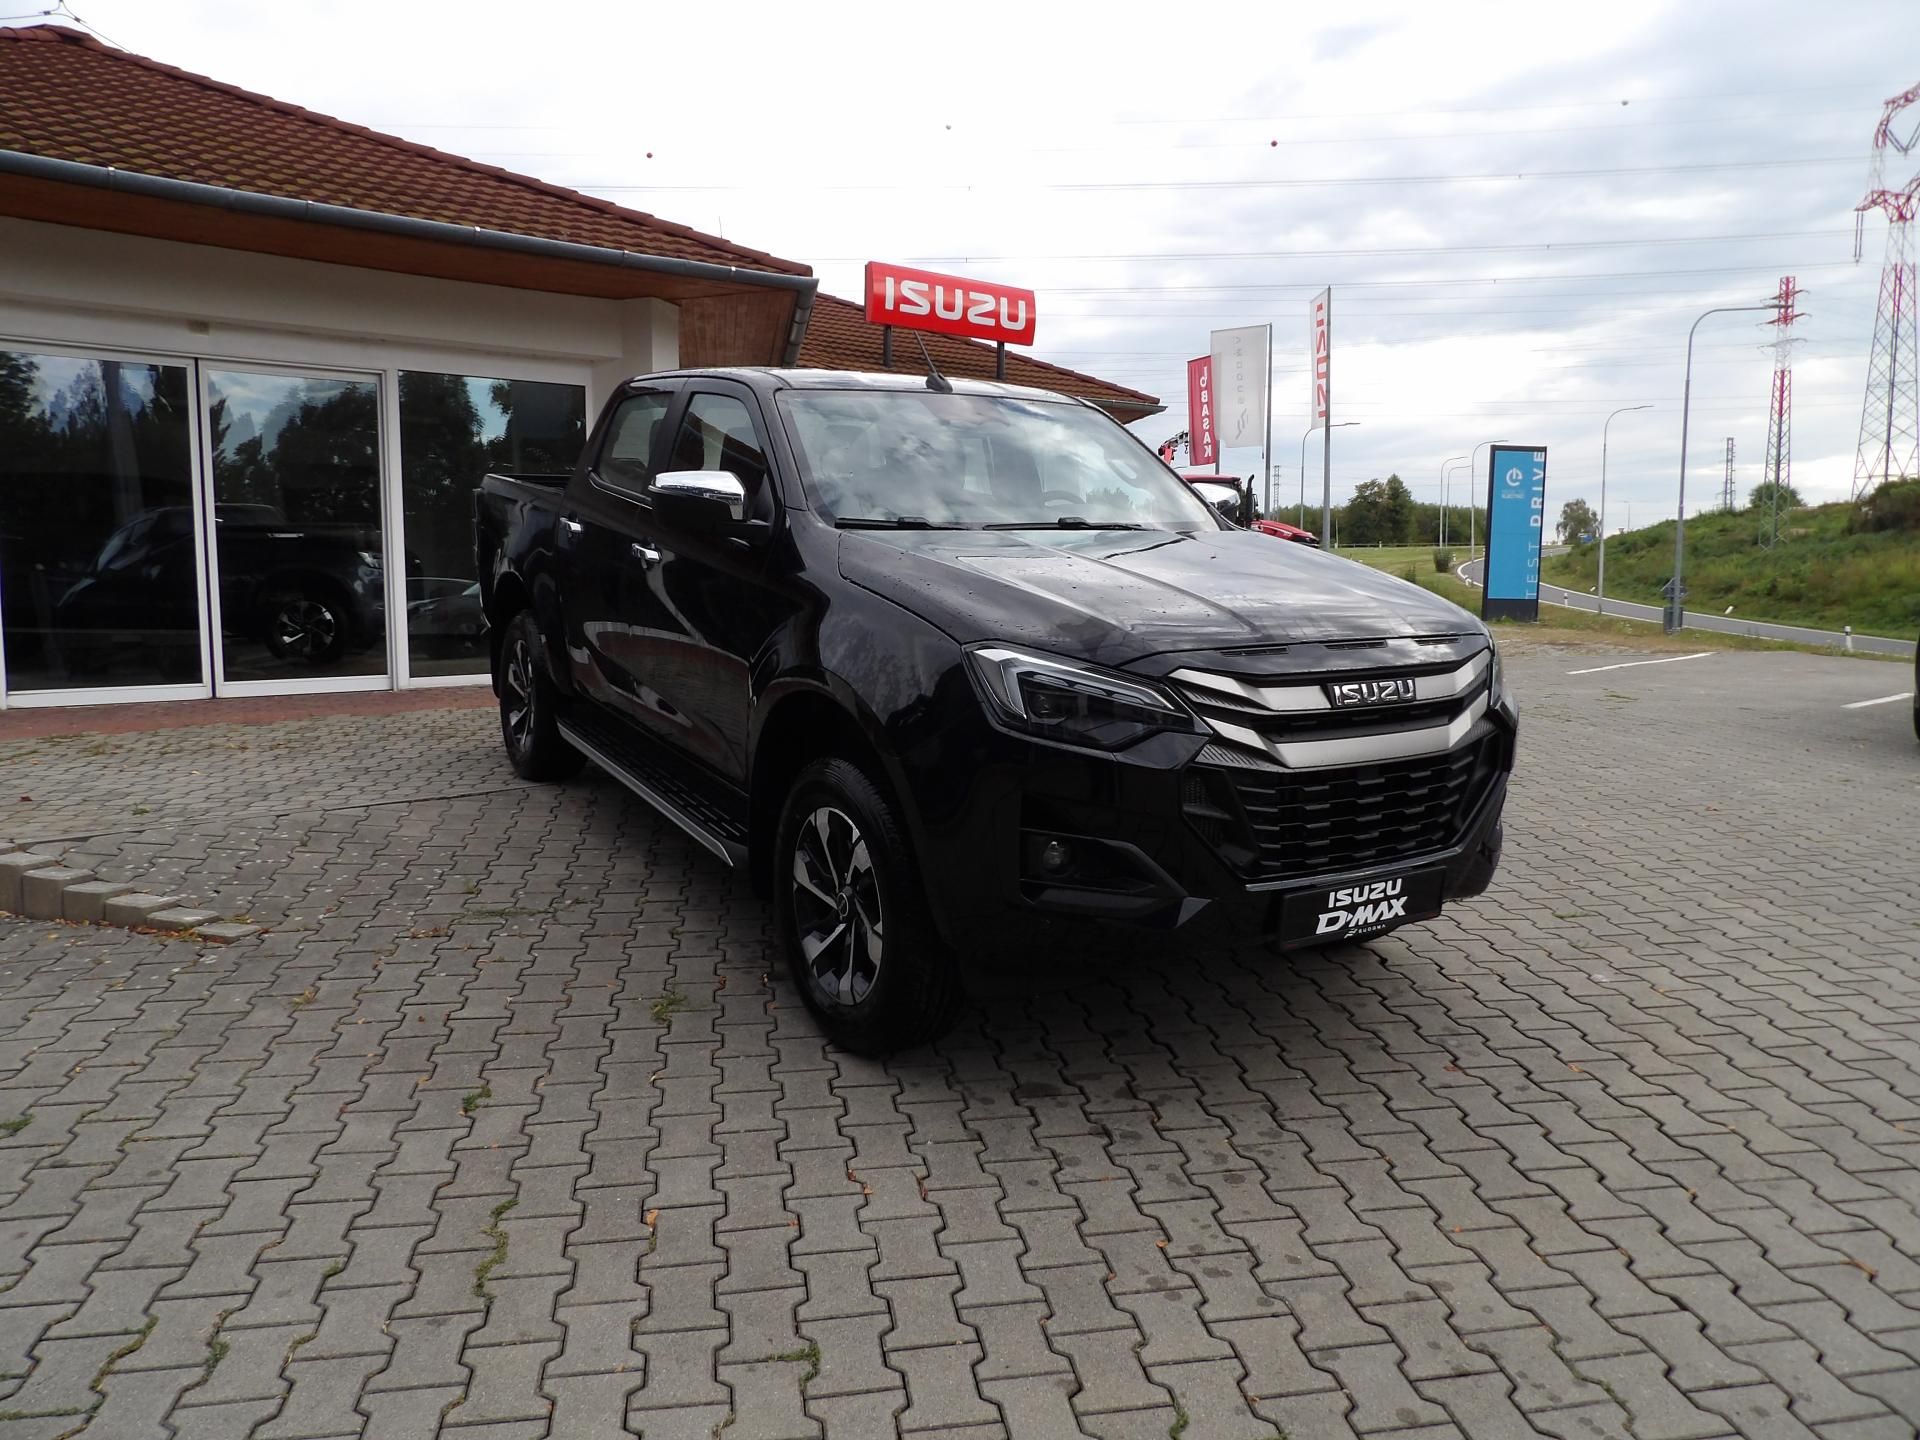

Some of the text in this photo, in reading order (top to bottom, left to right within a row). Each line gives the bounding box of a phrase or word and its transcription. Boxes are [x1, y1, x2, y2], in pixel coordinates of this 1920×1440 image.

[885, 277, 1026, 331] ISUZU
[1526, 452, 1545, 599] TEST DRIVE
[1333, 680, 1415, 706] ISUZU
[1328, 878, 1402, 908] ISUZU
